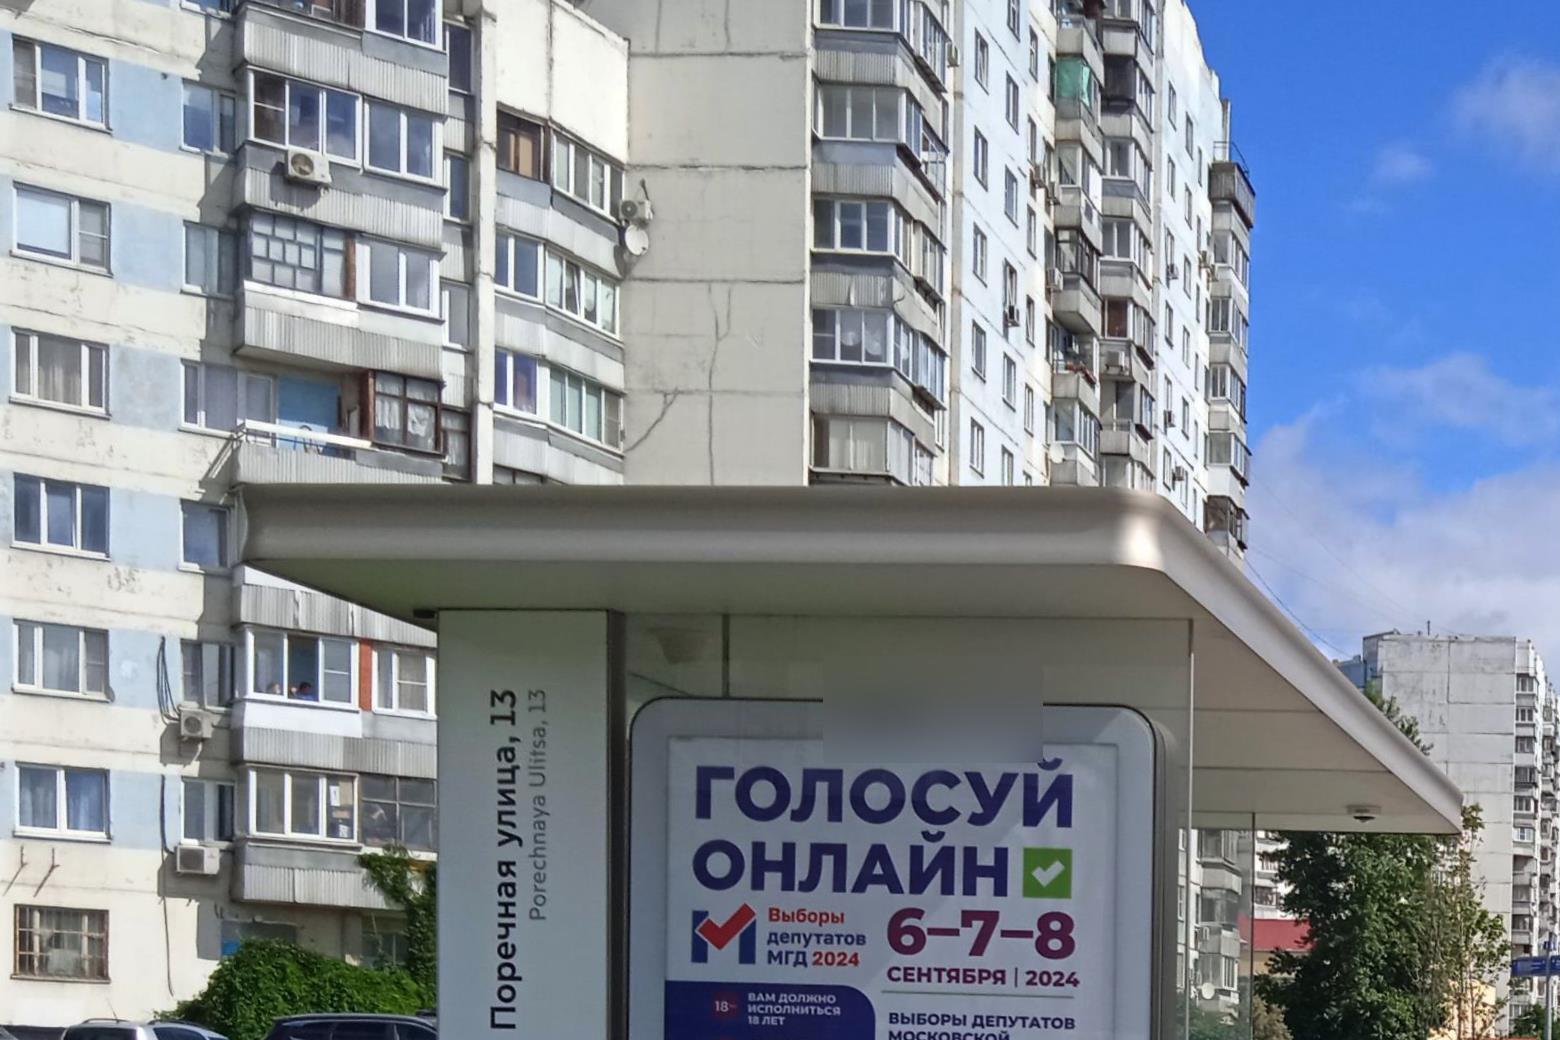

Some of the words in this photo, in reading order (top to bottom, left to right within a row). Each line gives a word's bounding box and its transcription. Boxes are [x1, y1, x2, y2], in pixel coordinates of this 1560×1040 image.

[490, 689, 517, 726] 13
[528, 688, 547, 713] 13
[528, 719, 549, 787] Ulitsa,
[497, 736, 522, 847] улица,
[695, 758, 1073, 828] ГОЛОСУЙ
[528, 795, 550, 921] Porechnaya
[692, 830, 1009, 897] ОНЛАЙН
[768, 907, 845, 926] Выборы
[490, 860, 522, 1030] Поречная
[767, 932, 866, 949] депутатов
[767, 951, 808, 968] МГД
[812, 951, 860, 967] 2024
[887, 966, 1006, 985] СЕНТЯБРЯ
[1025, 969, 1080, 987] 2024
[748, 993, 776, 1003] ВАМ
[778, 994, 836, 1005] ДОЛЖНО
[748, 1004, 841, 1016] ИСПОЛНИТЬСЯ
[748, 1016, 760, 1025] 18
[761, 1016, 785, 1026] ЛЕТ
[889, 1012, 967, 1027] ВЫБОРЫ
[971, 1014, 1076, 1030] ДЕПУТАТОВ
